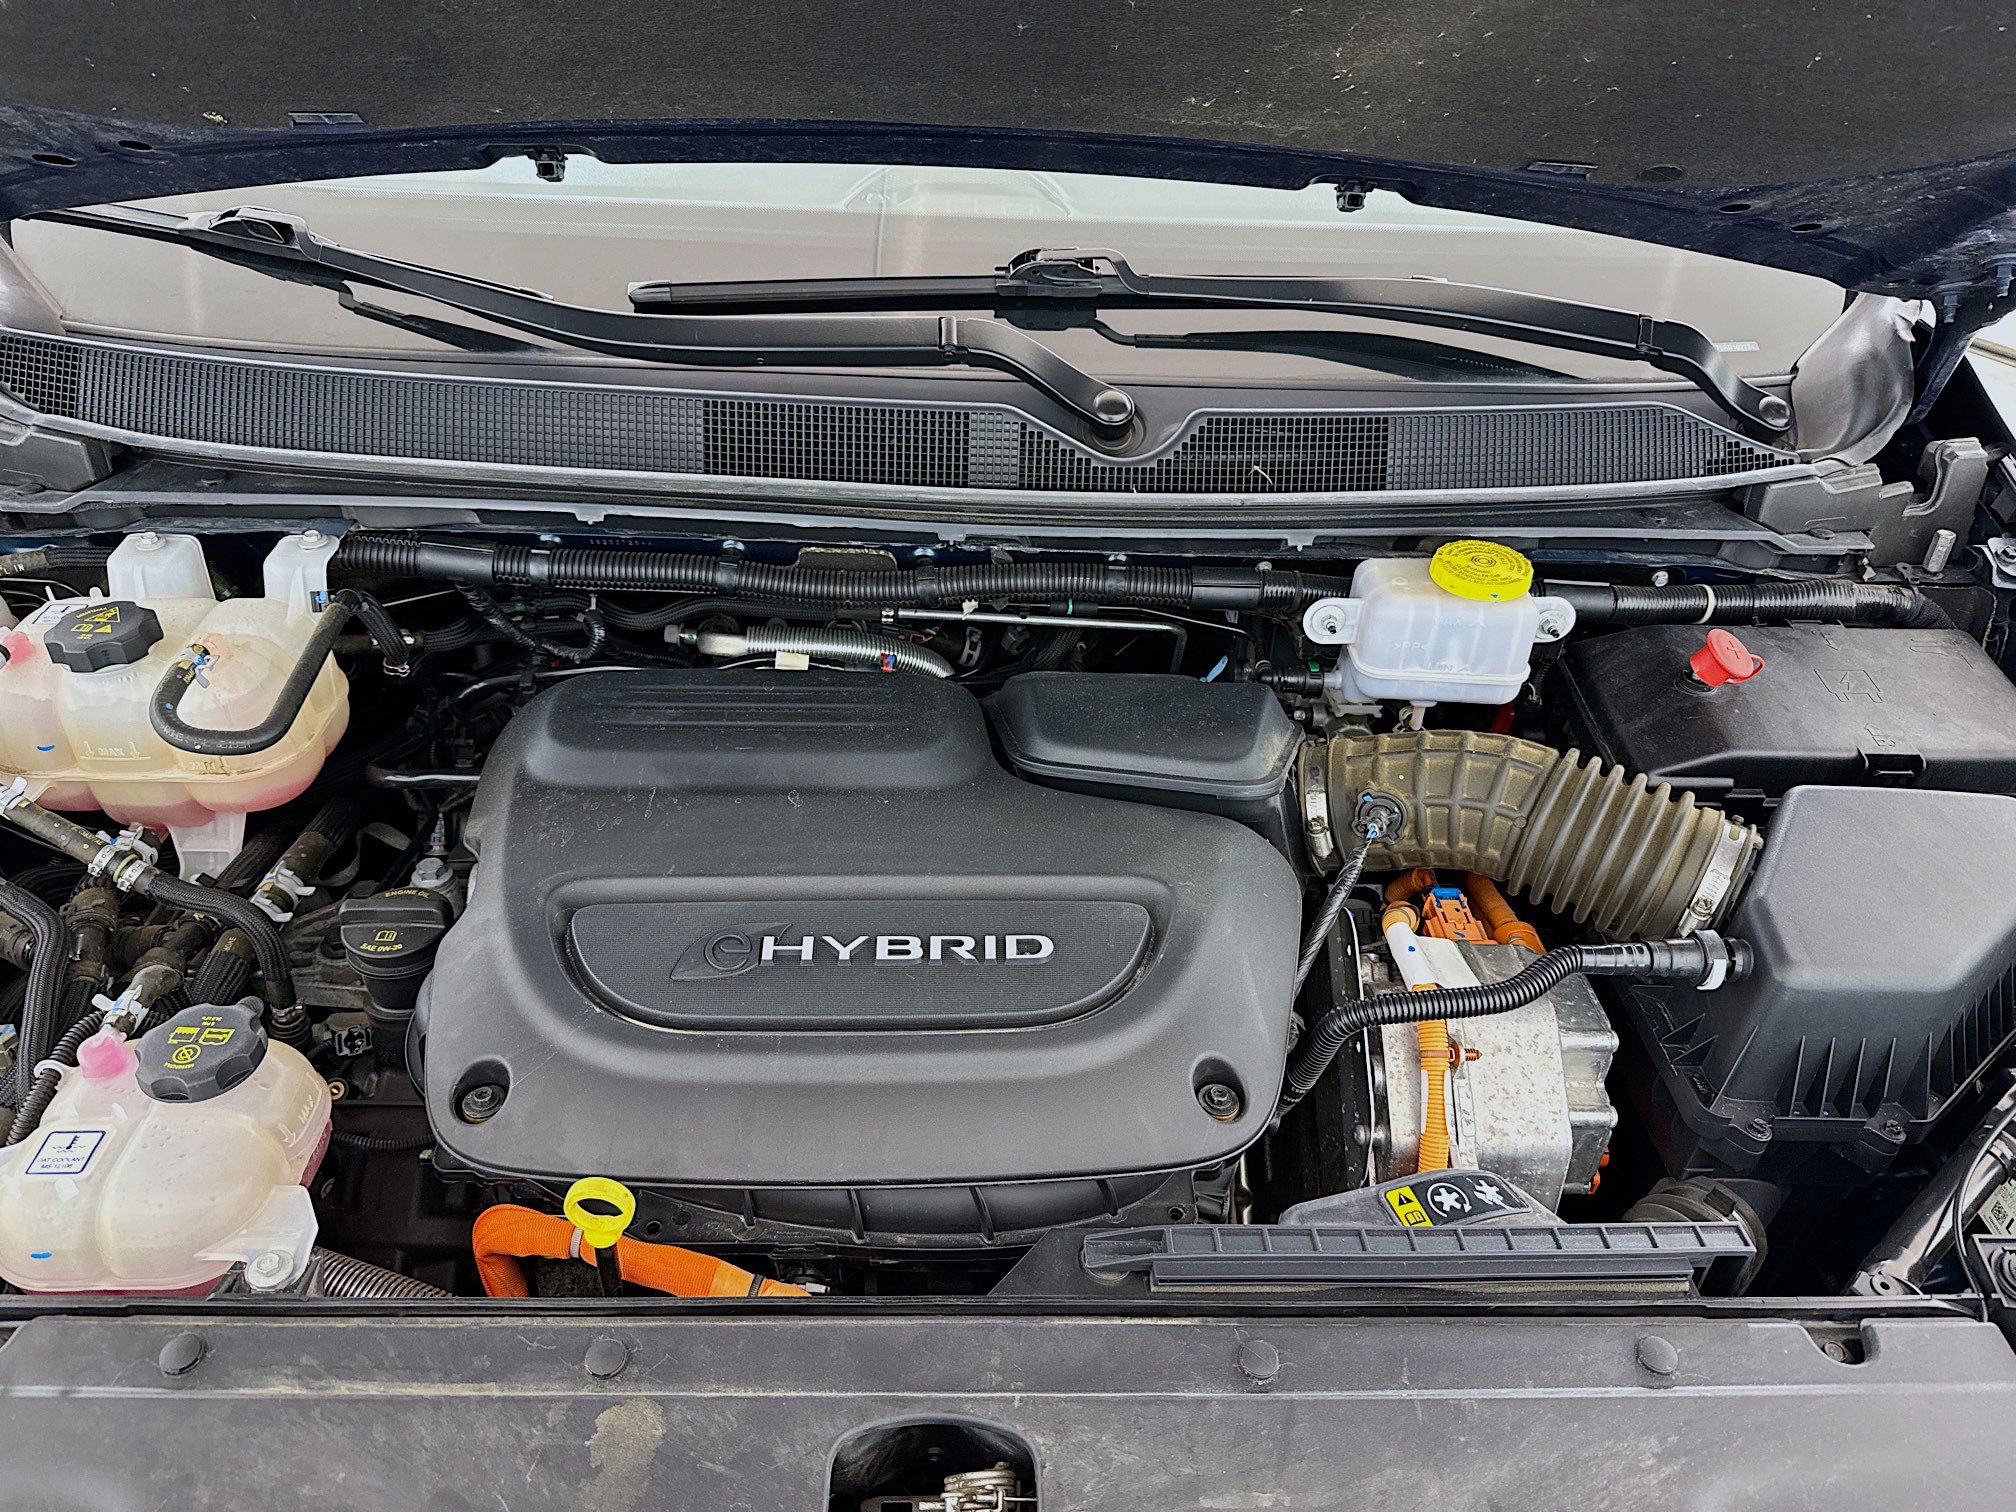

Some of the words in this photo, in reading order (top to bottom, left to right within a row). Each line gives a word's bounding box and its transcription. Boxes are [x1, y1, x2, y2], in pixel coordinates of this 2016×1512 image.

[384, 889, 417, 898] ENGINE
[418, 890, 430, 899] OIL
[360, 942, 377, 952] SAE
